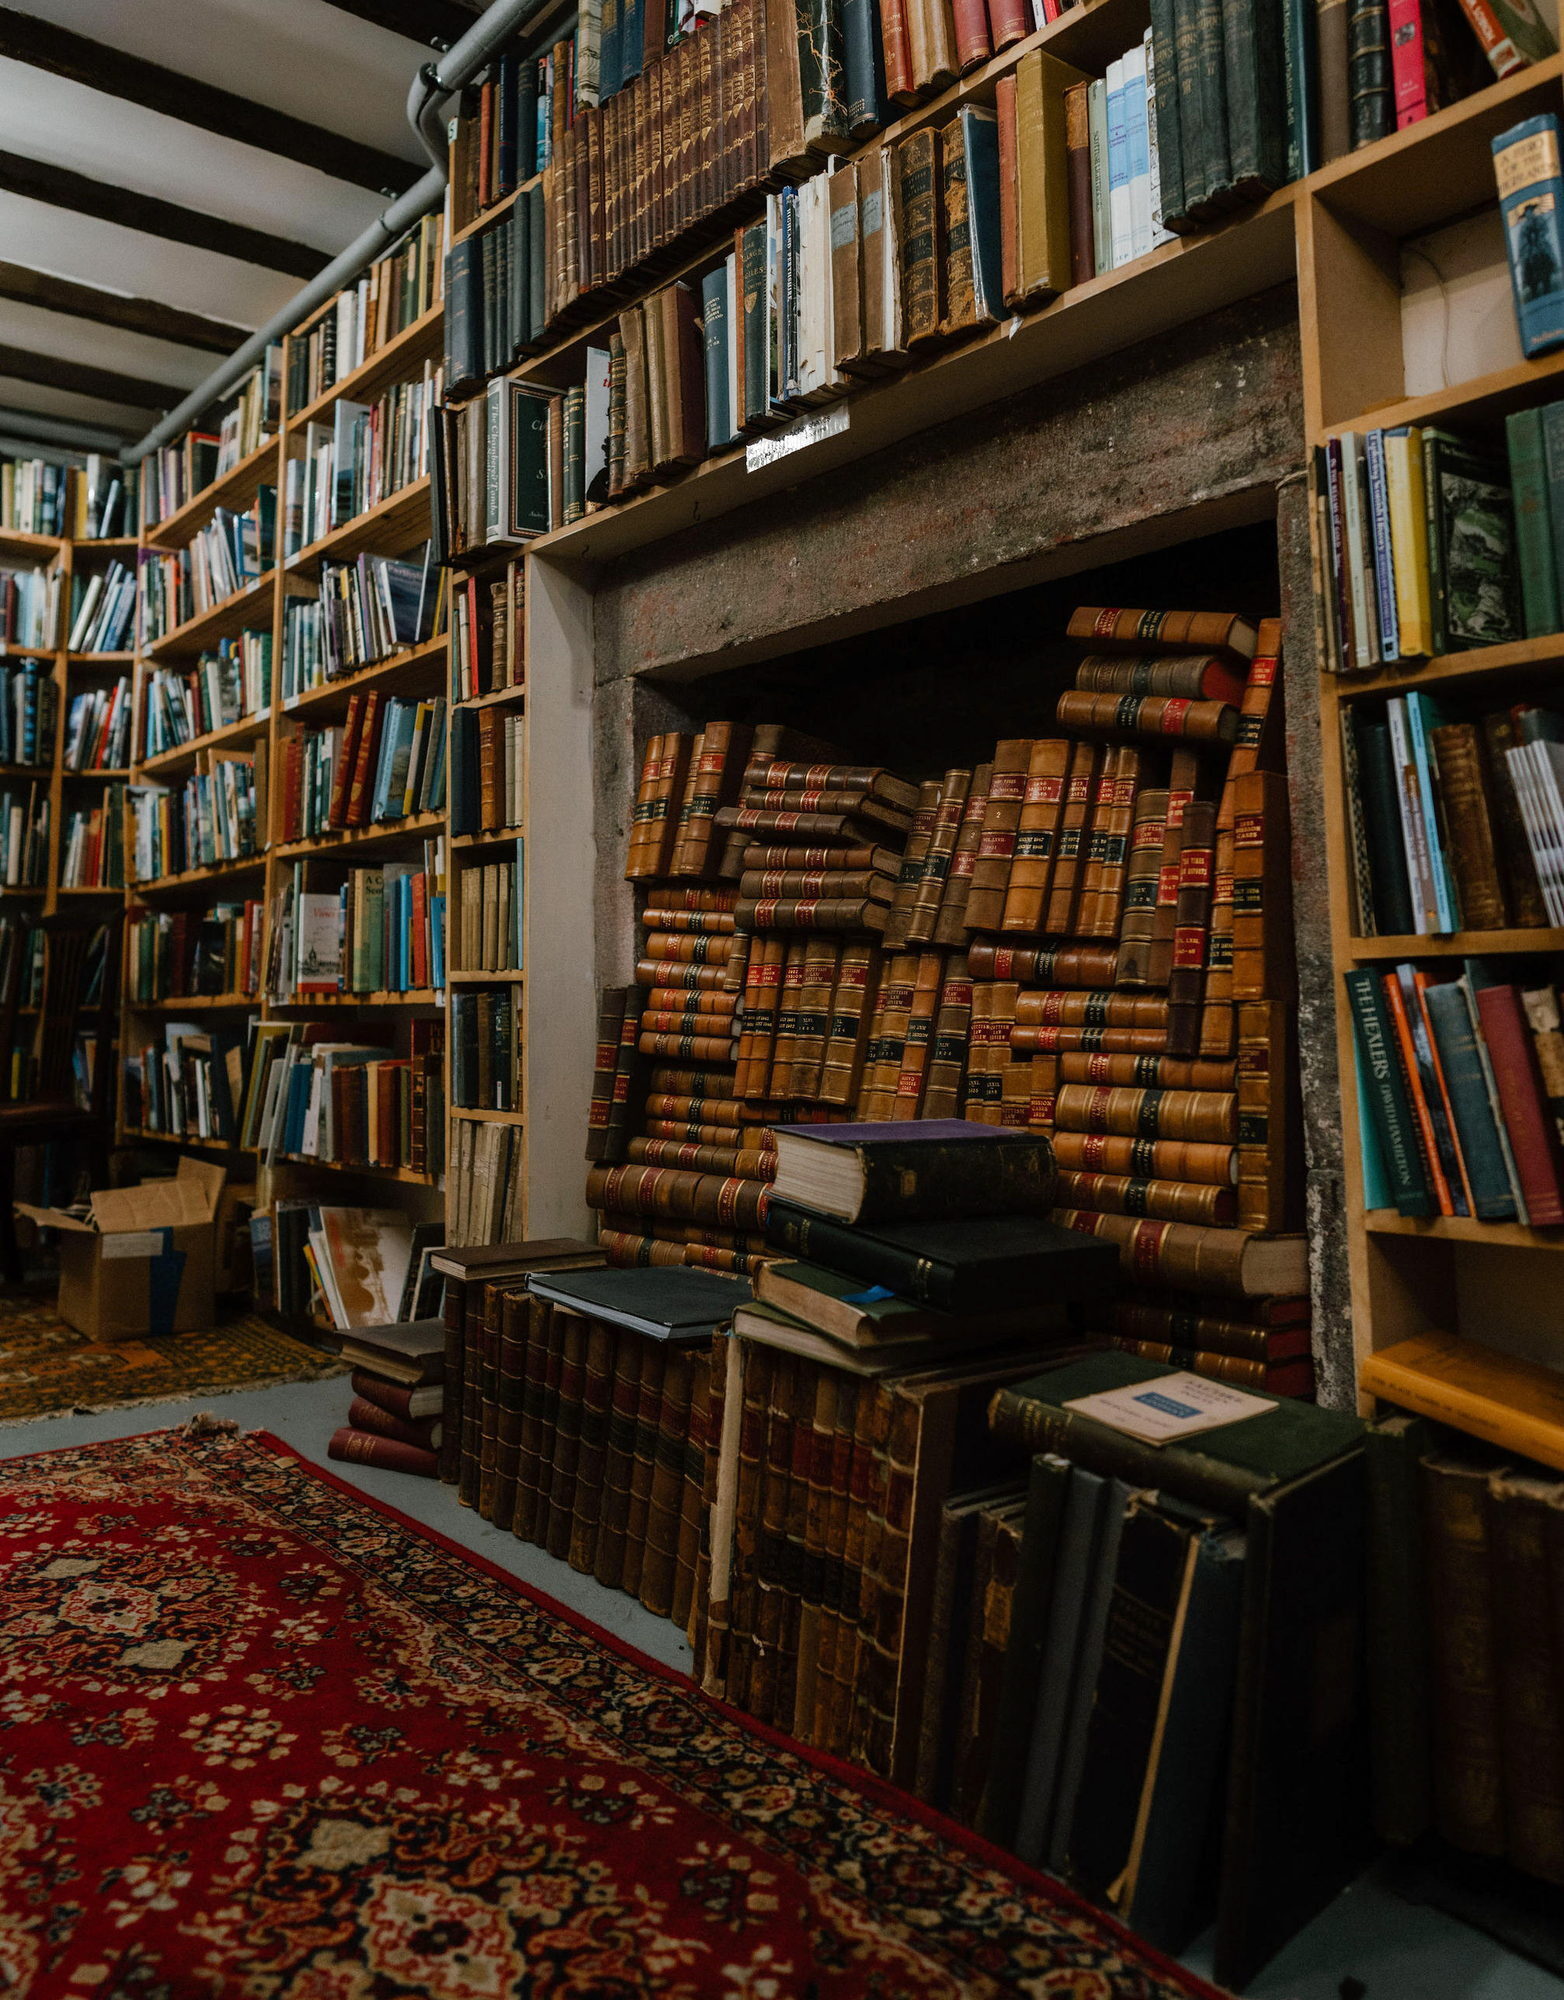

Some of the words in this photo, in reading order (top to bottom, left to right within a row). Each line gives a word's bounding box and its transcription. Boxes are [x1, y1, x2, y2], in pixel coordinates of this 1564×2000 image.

[1368, 433, 1379, 478] Exploring
[490, 482, 498, 516] Tombs
[1354, 977, 1374, 1004] THE
[1360, 1004, 1392, 1080] HEALERS
[1380, 1084, 1398, 1120] DAVID
[1389, 1120, 1412, 1186] HAMILTON
